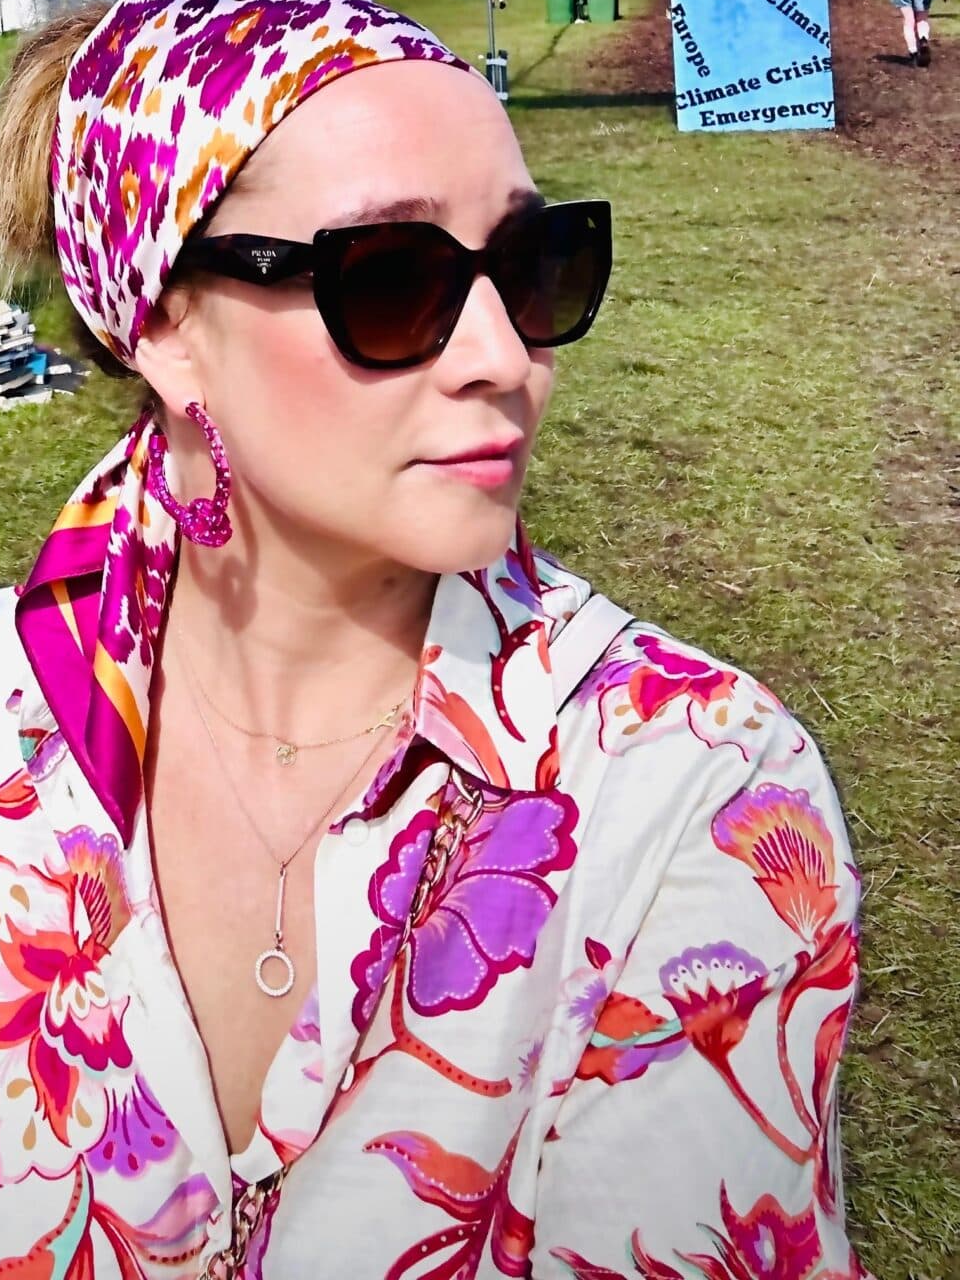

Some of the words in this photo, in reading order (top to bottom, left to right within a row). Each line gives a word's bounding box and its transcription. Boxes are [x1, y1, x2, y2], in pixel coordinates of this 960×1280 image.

[671, 3, 711, 78] Europe
[766, 54, 833, 85] Crisis
[698, 100, 836, 127] Emergency
[251, 250, 277, 258] PRADA
